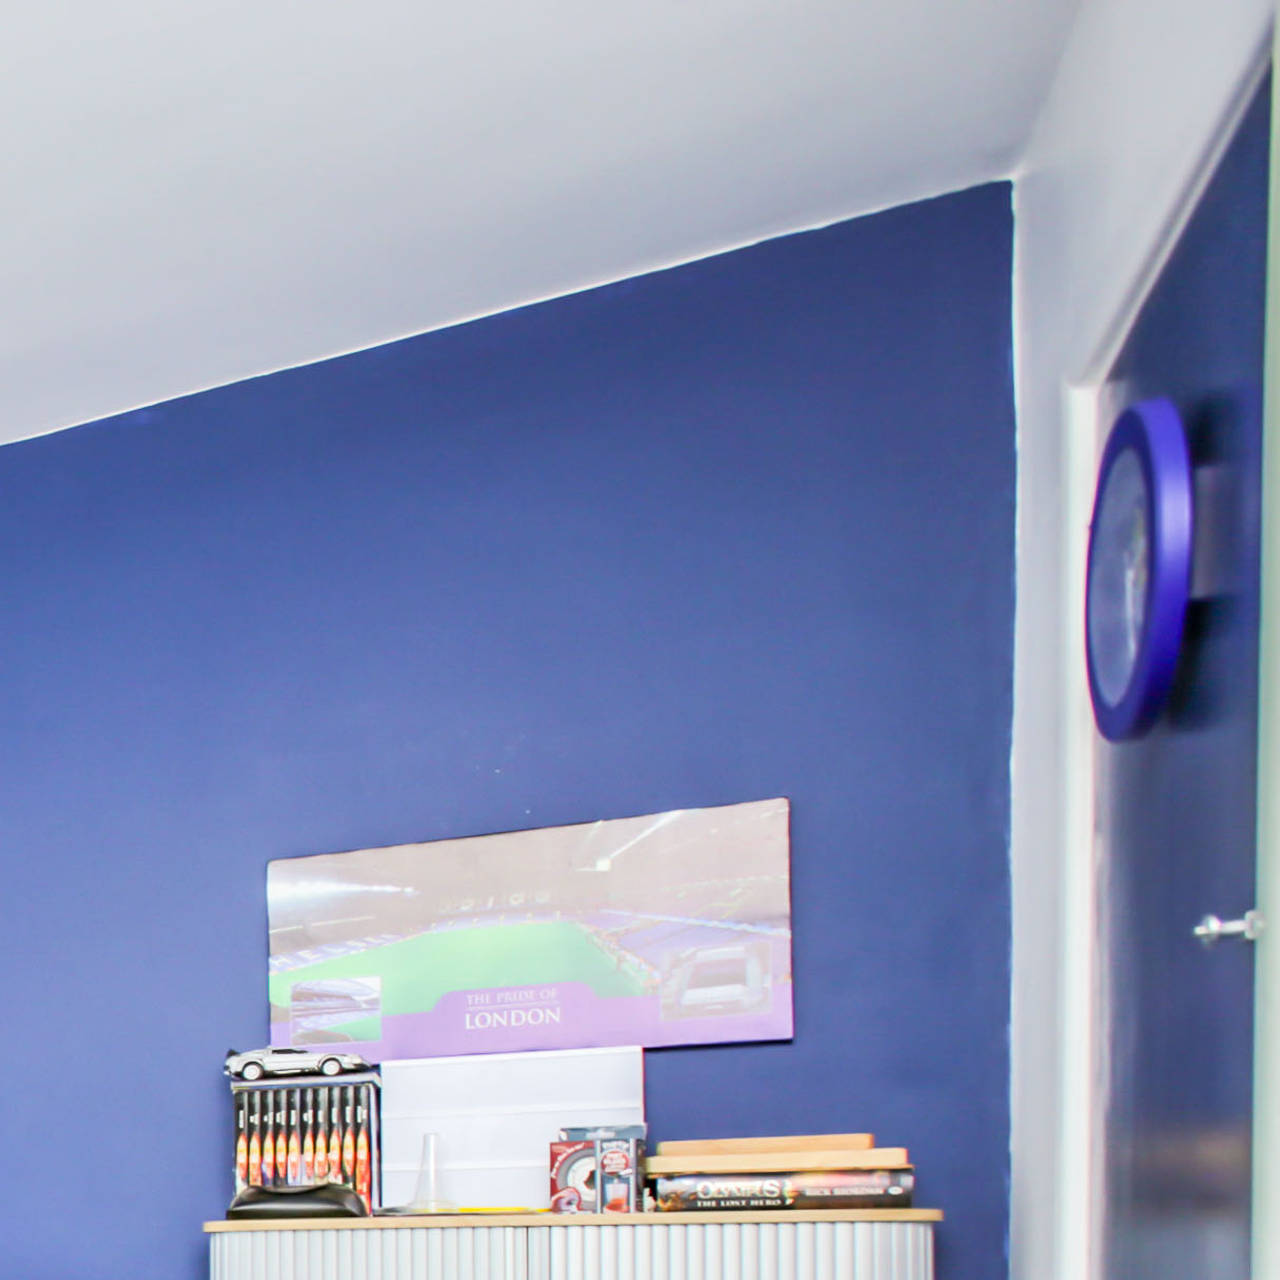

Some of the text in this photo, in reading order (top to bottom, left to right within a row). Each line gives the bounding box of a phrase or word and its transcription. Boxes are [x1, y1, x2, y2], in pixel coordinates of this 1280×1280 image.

[496, 990, 536, 1003] PRIDE
[539, 988, 557, 1001] OF
[465, 1007, 561, 1030] LONDON
